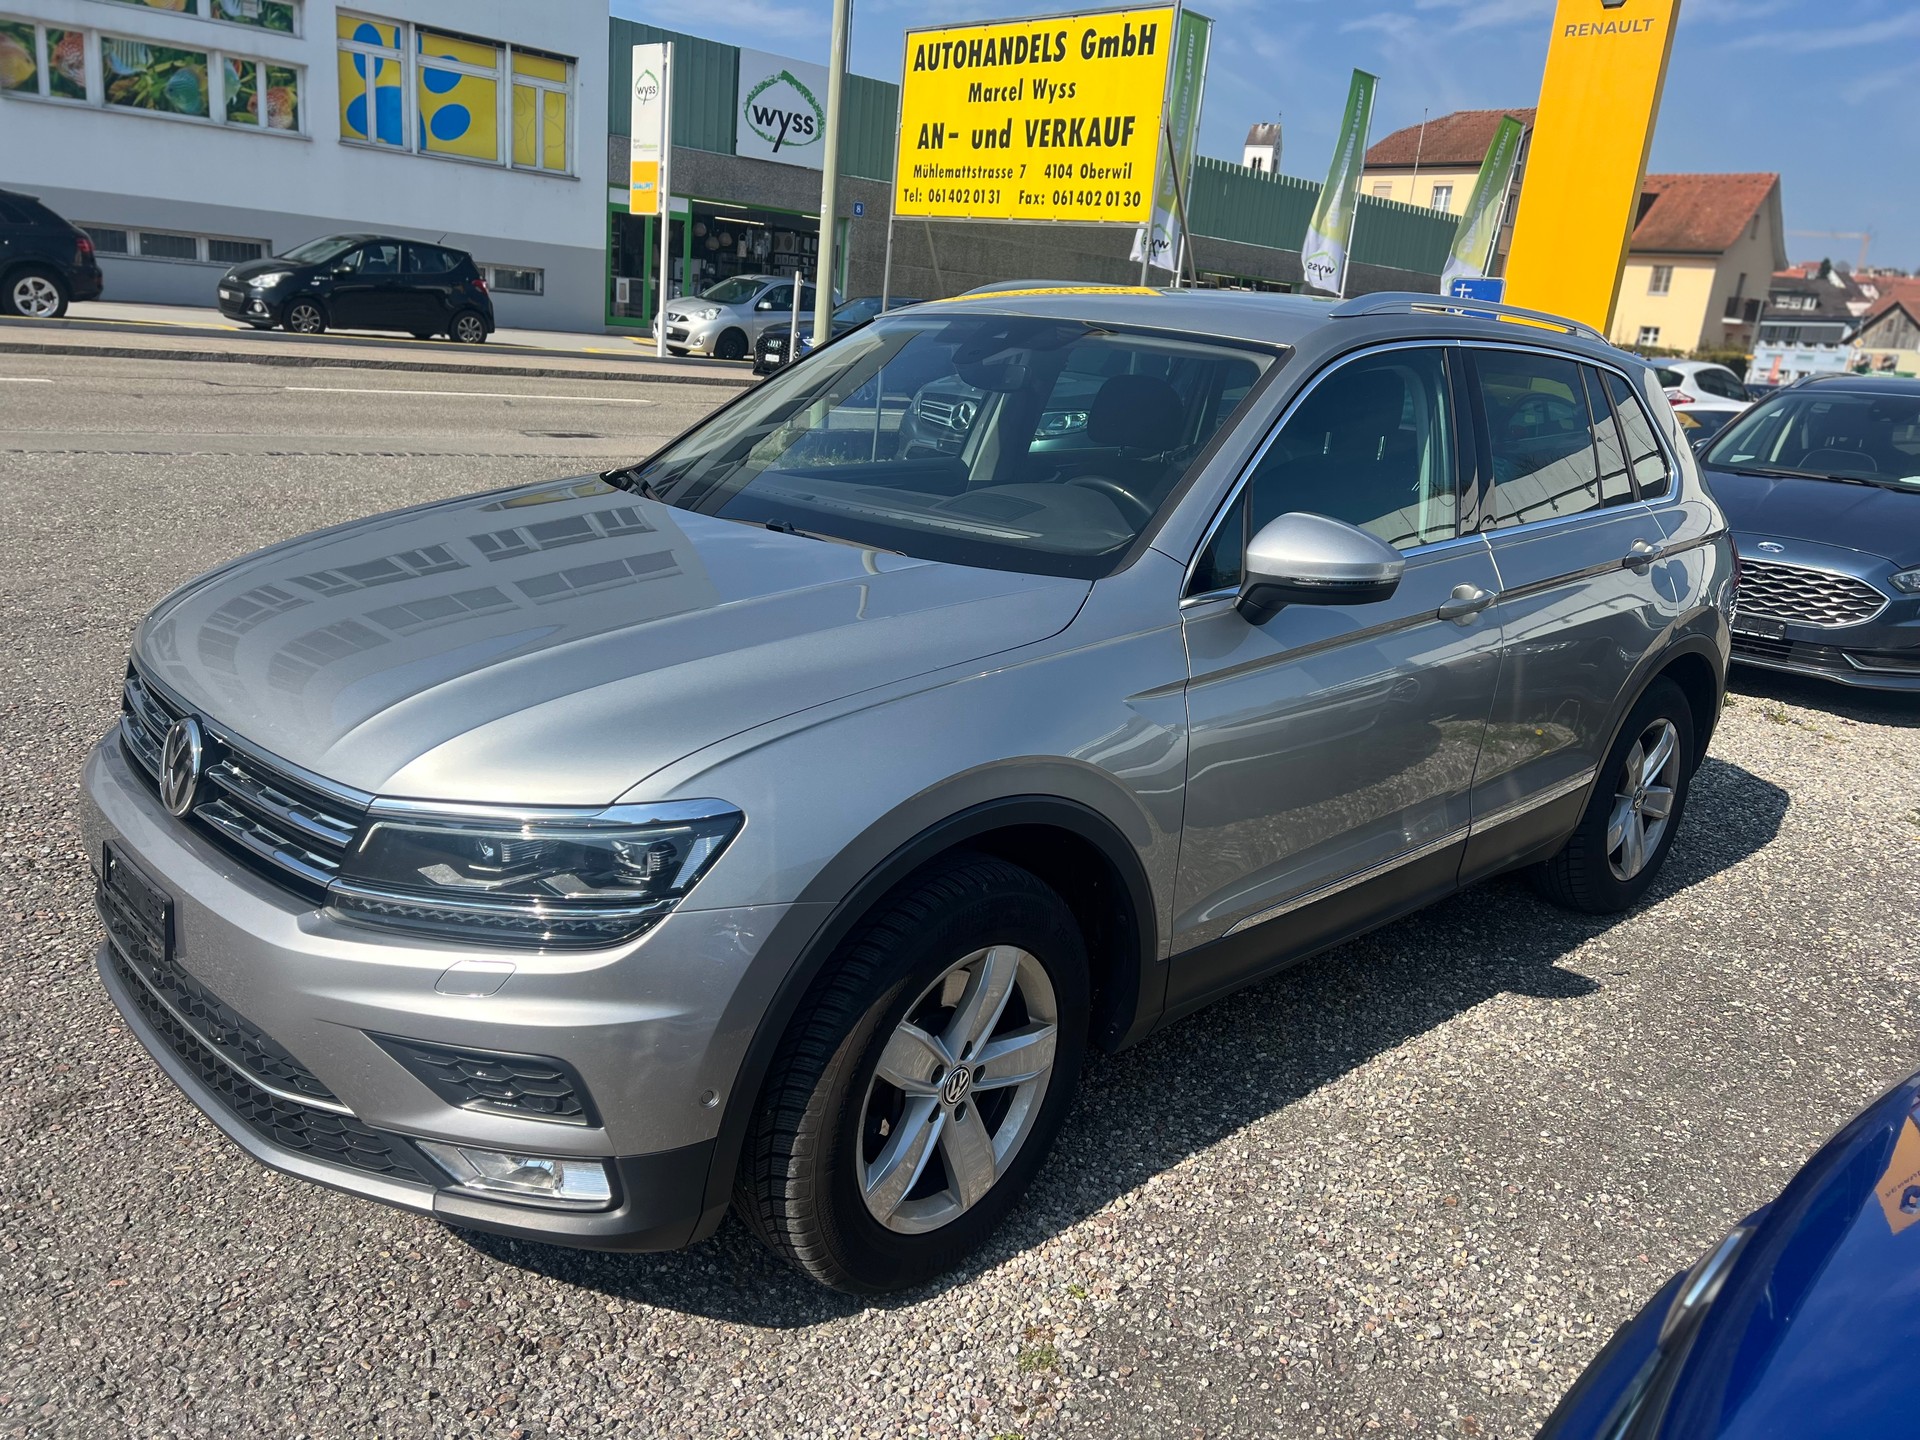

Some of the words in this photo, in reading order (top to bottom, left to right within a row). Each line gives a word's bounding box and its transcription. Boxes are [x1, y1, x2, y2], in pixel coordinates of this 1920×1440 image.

[1565, 18, 1655, 37] RENAULT
[913, 31, 1067, 71] AUTOHANDELS
[1081, 23, 1157, 60] GmbH
[637, 85, 656, 105] wyss
[968, 78, 1023, 102] Marcel
[1032, 79, 1077, 104] Wyss
[753, 104, 814, 153] wyss
[917, 122, 959, 149] AN-
[971, 118, 1012, 149] und
[1025, 116, 1136, 147] VERKAUF
[913, 163, 1013, 179] Mühlemattstrasse
[1020, 164, 1027, 179] 7
[1044, 163, 1073, 179] 4104
[1080, 162, 1132, 179] Oberwil
[904, 187, 922, 202] Tel:
[1018, 190, 1045, 205] Fax:
